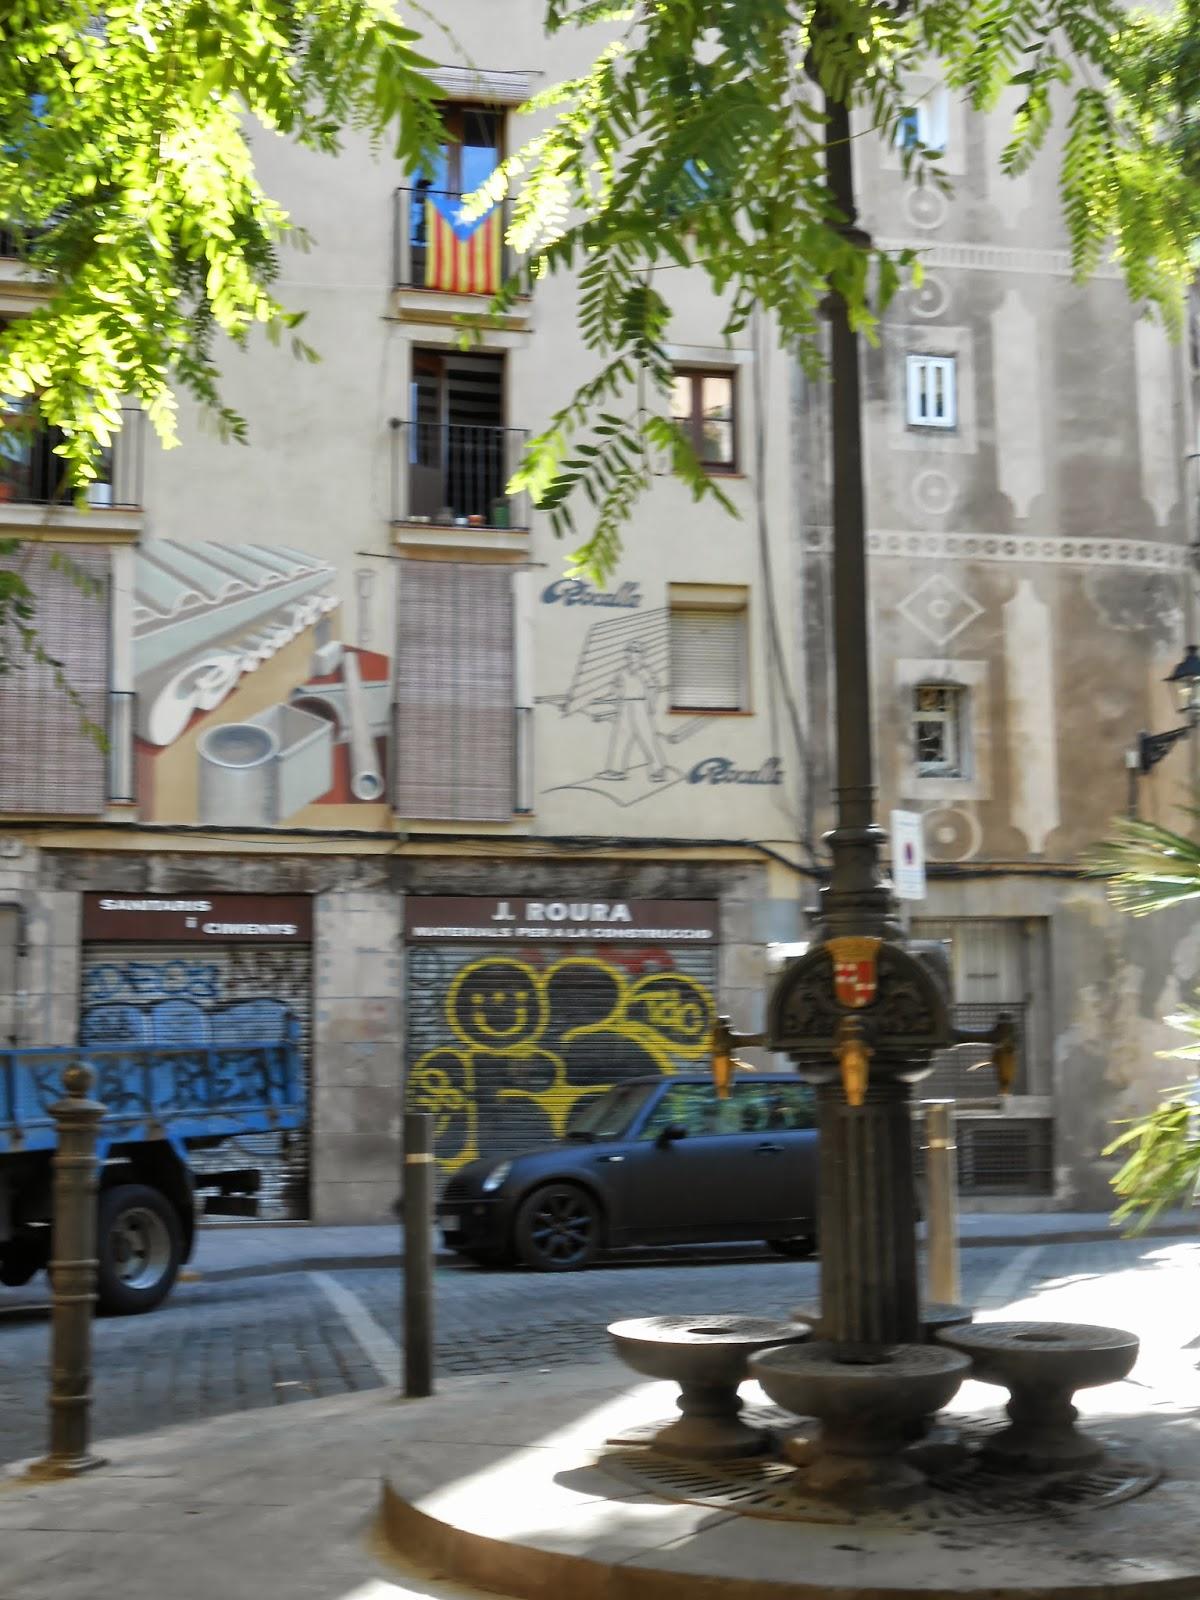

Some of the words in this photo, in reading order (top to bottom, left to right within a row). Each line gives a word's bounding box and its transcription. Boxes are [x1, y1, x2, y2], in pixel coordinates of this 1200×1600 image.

[525, 903, 633, 922] ROURA
[202, 922, 298, 935] CIMENTS
[412, 927, 512, 937] MATERIALS
[515, 928, 549, 938] PER
